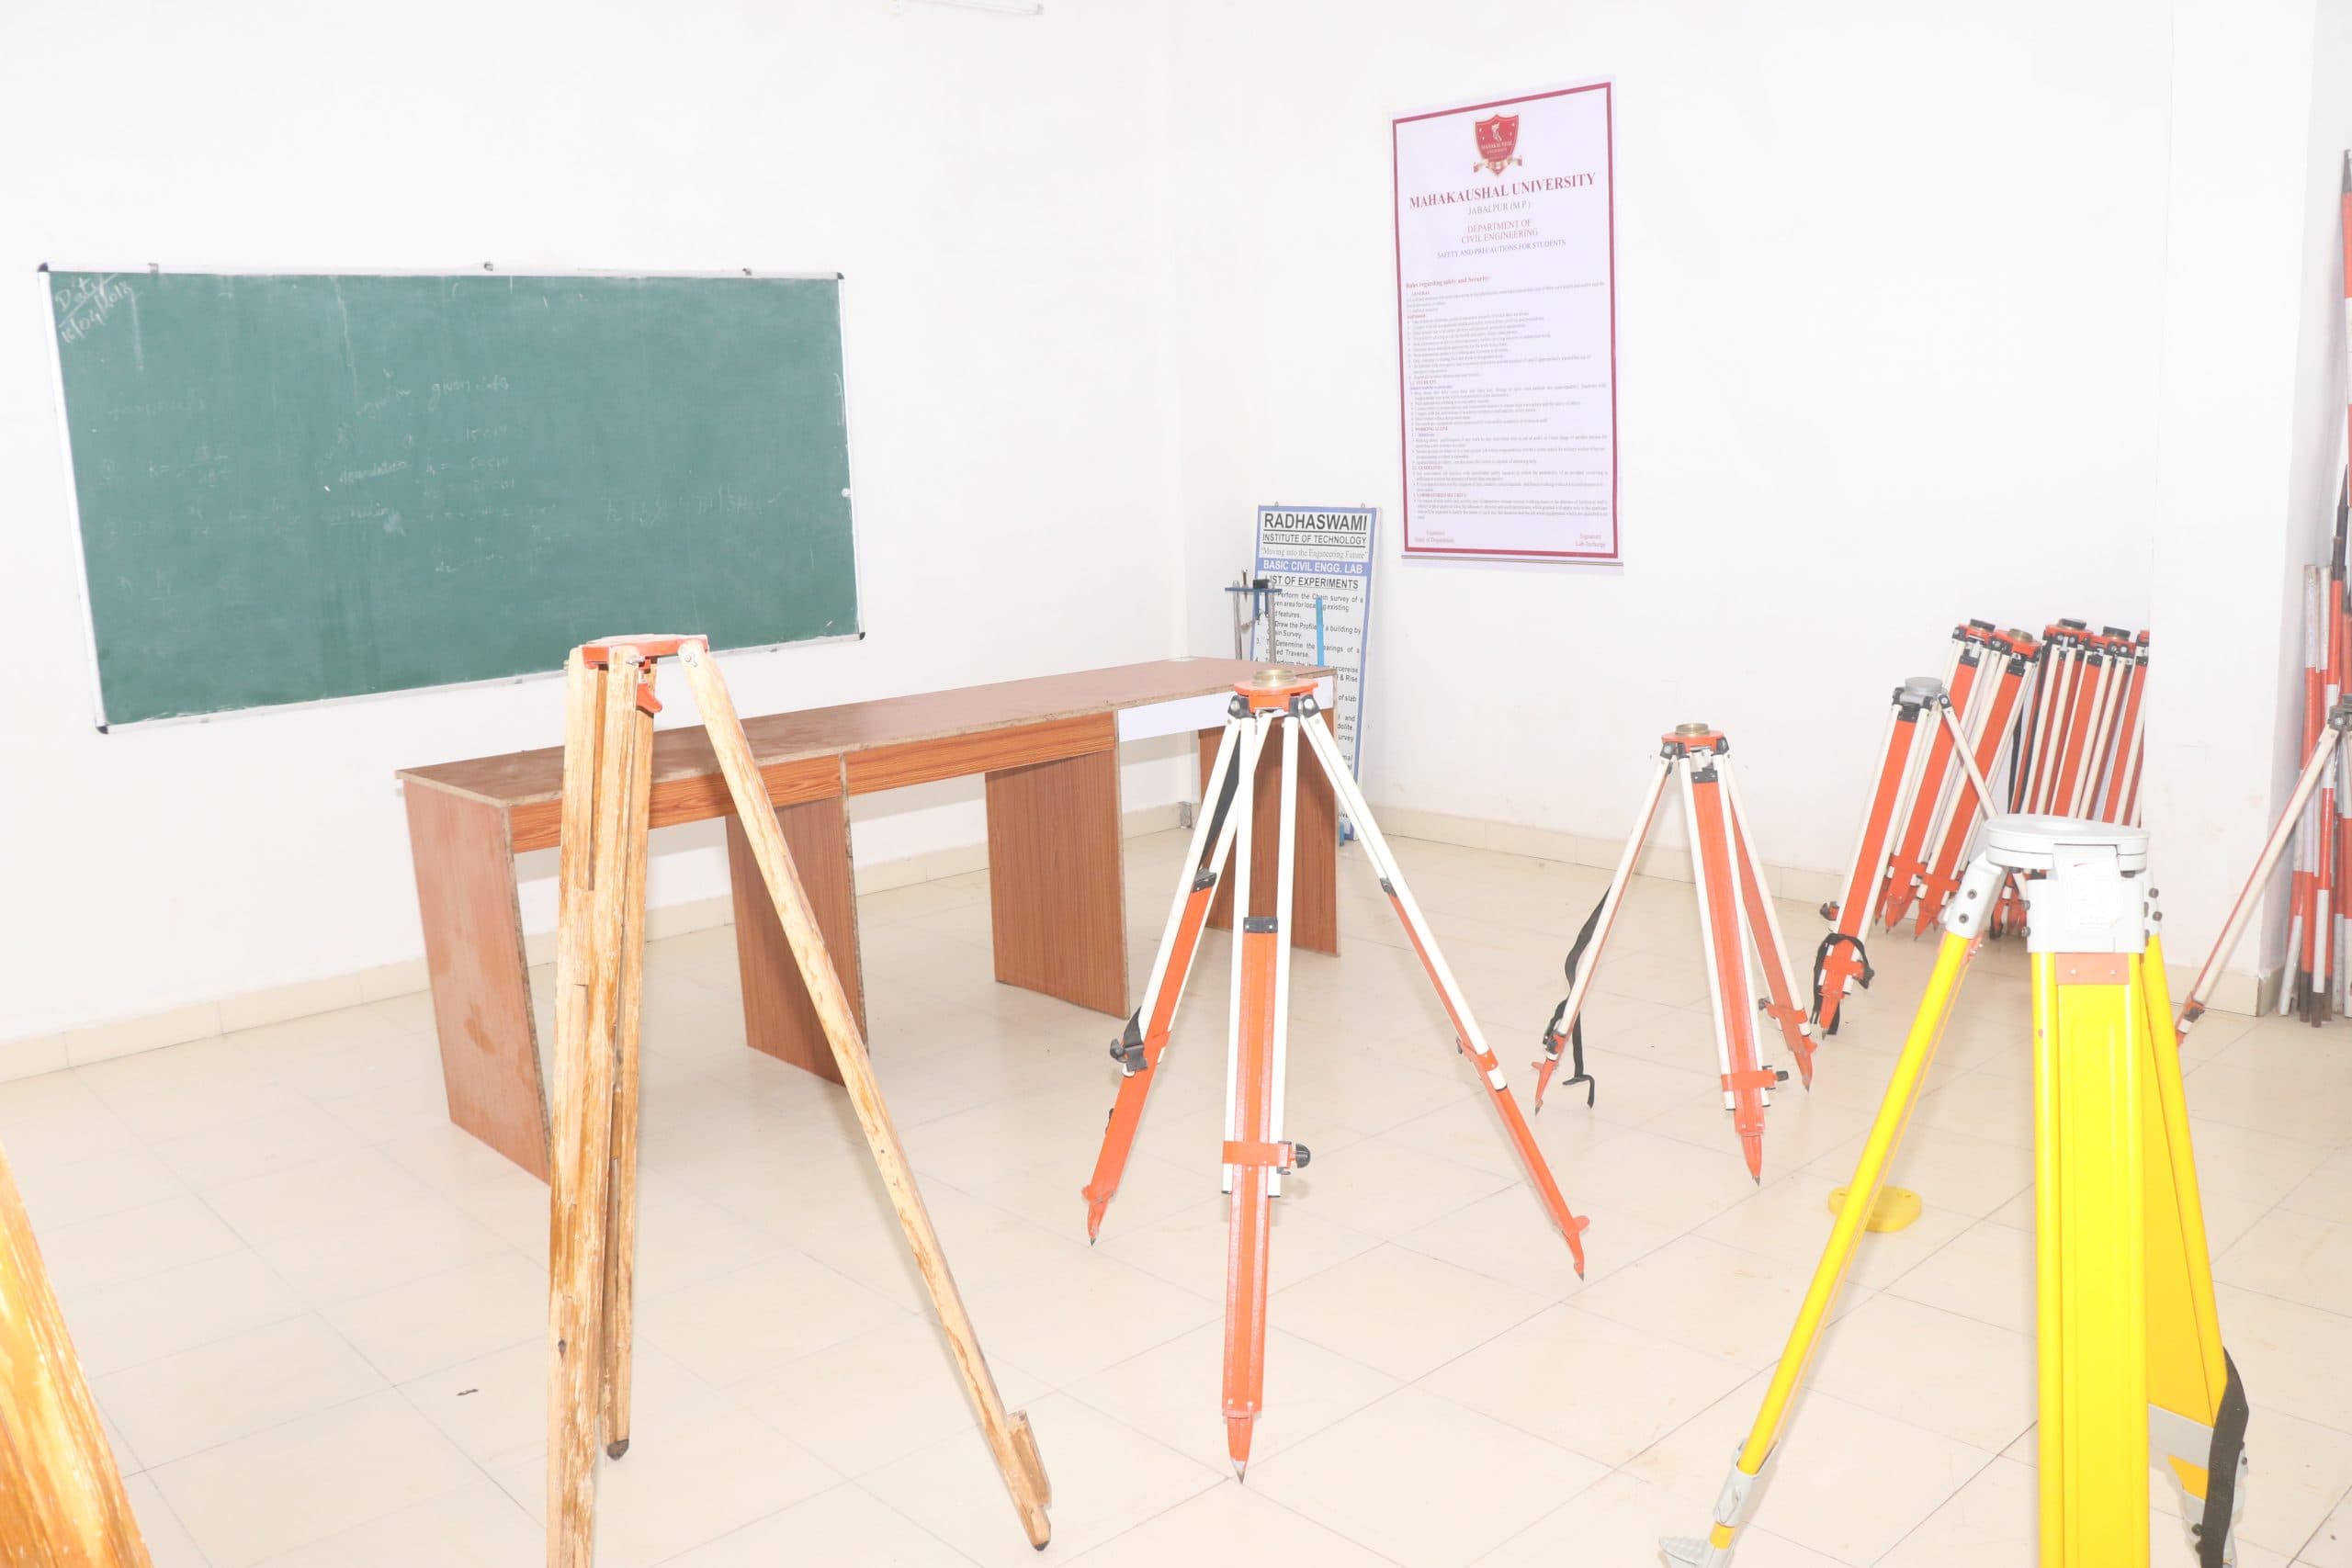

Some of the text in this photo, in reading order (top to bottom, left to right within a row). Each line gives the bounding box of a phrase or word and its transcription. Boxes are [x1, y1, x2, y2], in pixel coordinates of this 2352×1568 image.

[1409, 172, 1596, 209] MAHAKAUSHAL UNIVERSITY
[1467, 202, 1510, 216] JABALPUR
[1467, 220, 1520, 233] DEPARTMENT
[1484, 227, 1539, 243] ENGINEERING
[1264, 513, 1368, 532] RADHASWAMI
[1262, 534, 1367, 546] INSTITUTE OF TECHNOLOGY
[1308, 549, 1344, 559] Engineering
[1263, 559, 1290, 571] BASIC
[1344, 563, 1363, 574] LAB
[1284, 576, 1296, 585] OF
[1298, 577, 1359, 590] EXPERIMENTS
[1330, 595, 1350, 604] survey
[1305, 602, 1327, 612] locag
[1328, 603, 1350, 613] existing
[1329, 625, 1353, 635] building
[1353, 626, 1362, 636] by
[1323, 645, 1343, 654] arings
[1345, 674, 1358, 682] Rise
[1344, 694, 1357, 703] slab
[1338, 734, 1354, 743] urvey
